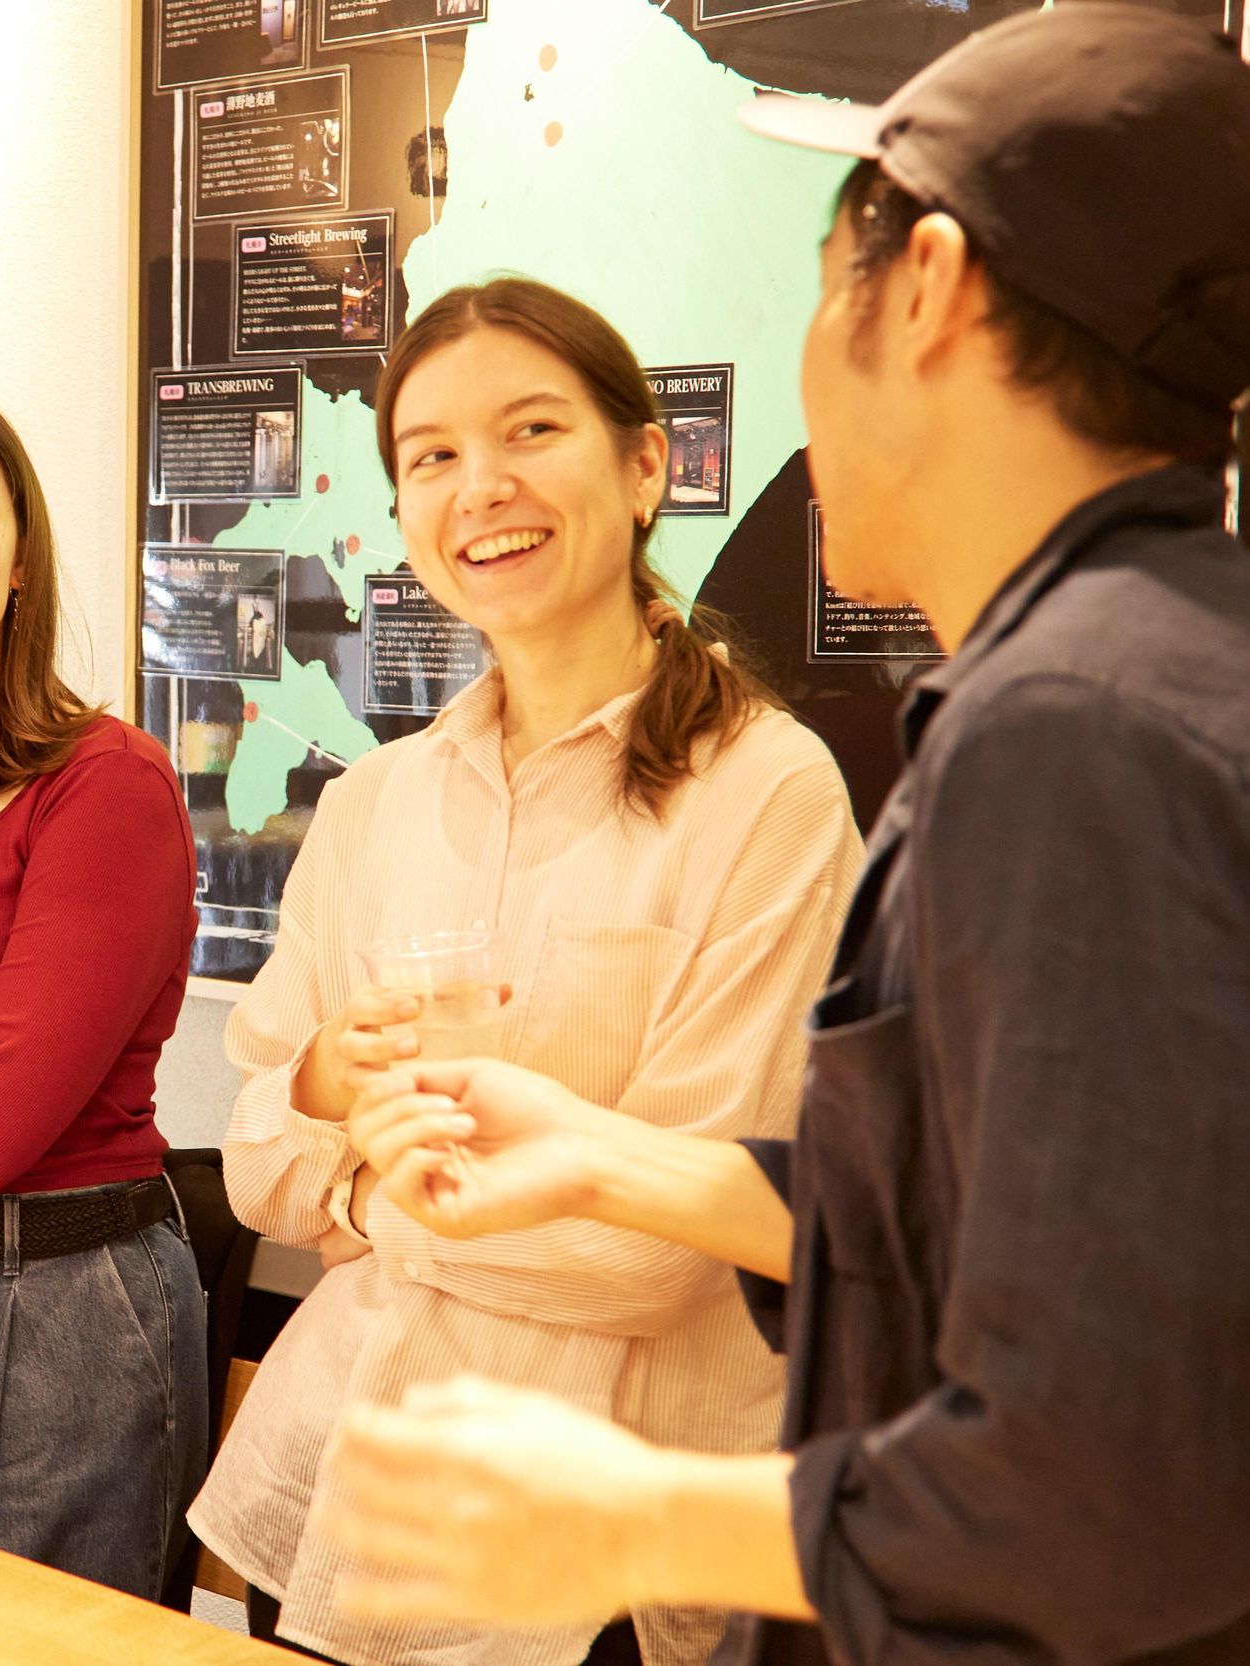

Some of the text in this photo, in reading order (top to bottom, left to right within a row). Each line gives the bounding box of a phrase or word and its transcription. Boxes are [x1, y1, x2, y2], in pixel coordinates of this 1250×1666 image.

[269, 226, 368, 247] Streetlight Brewing
[187, 378, 274, 395] TRANSBREWING
[666, 376, 723, 394] BREWERY
[198, 559, 216, 573] Fox
[218, 559, 241, 573] Beer
[402, 585, 429, 600] Lake
